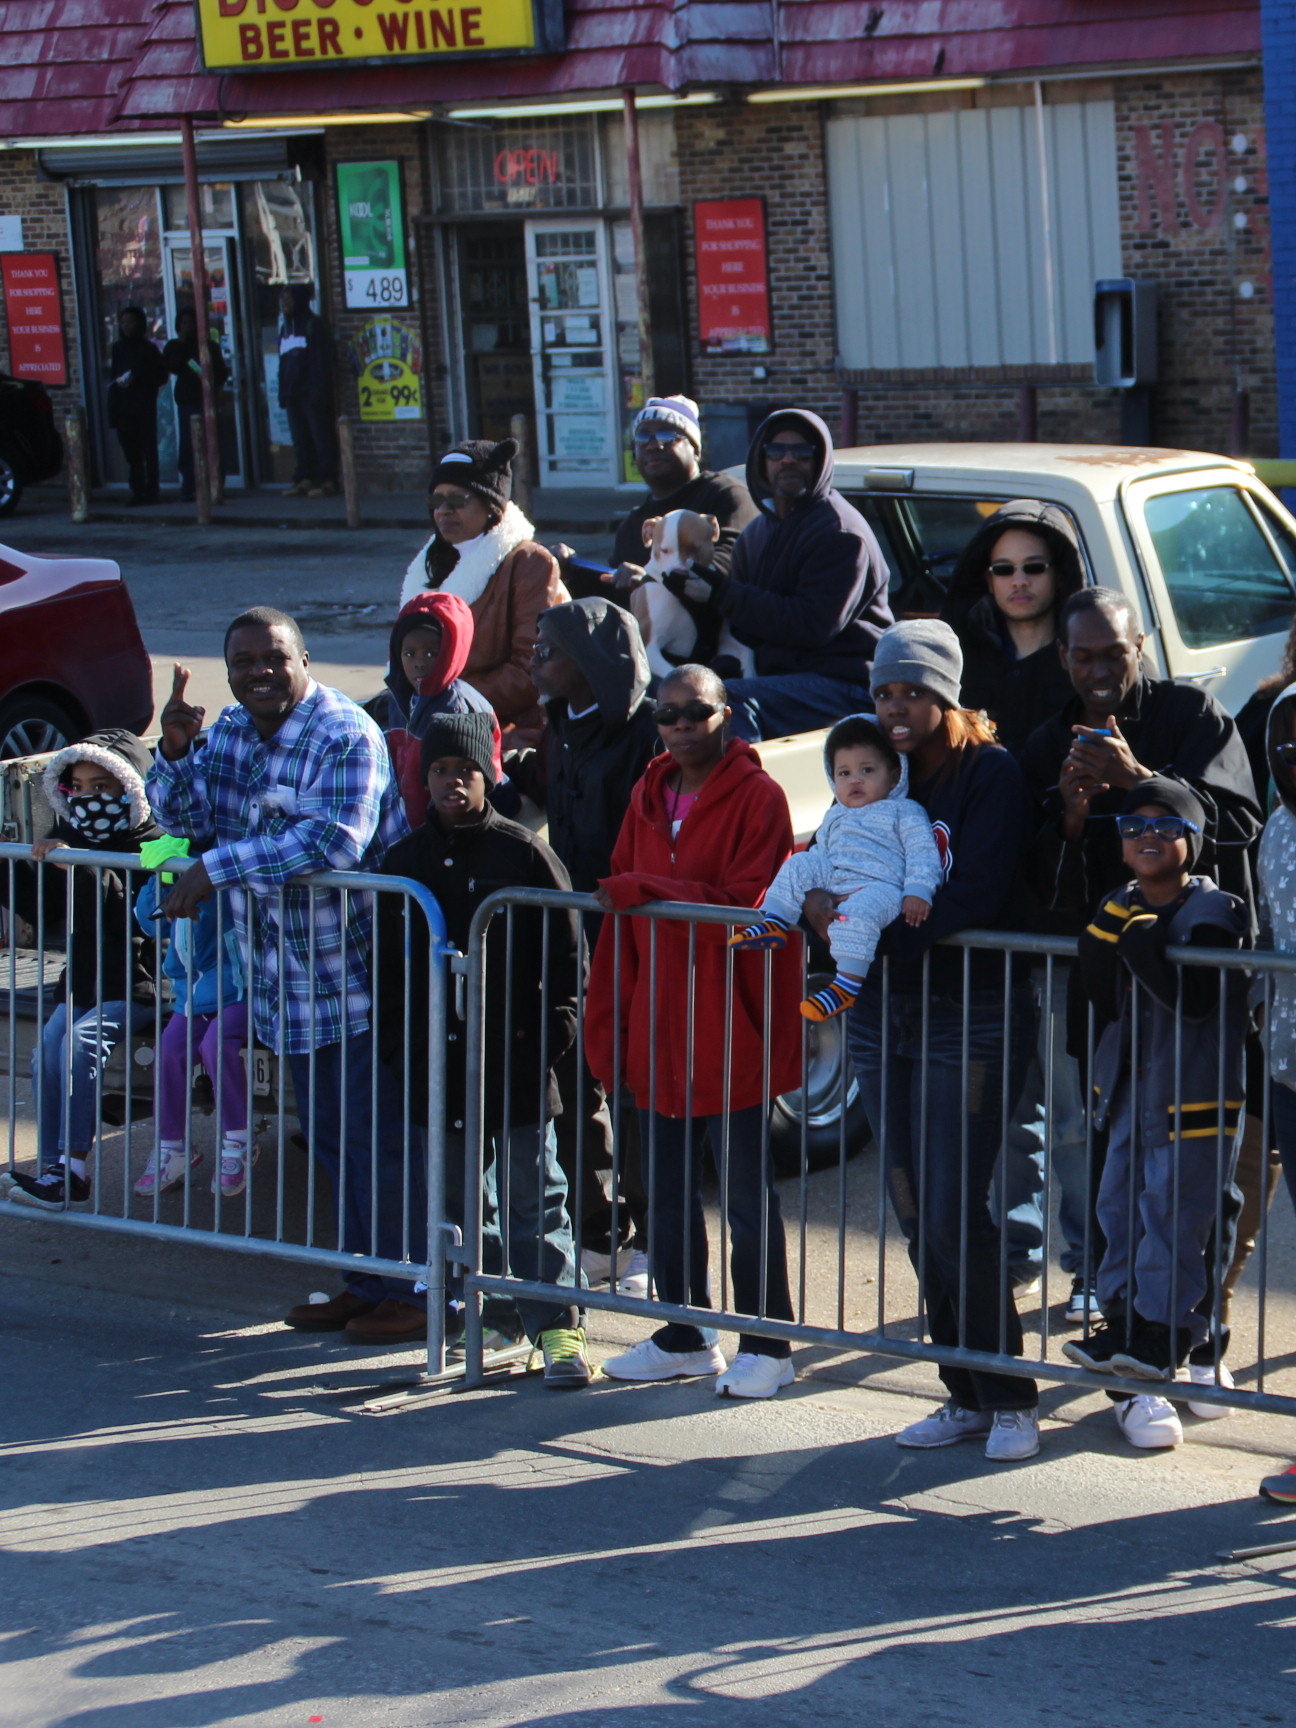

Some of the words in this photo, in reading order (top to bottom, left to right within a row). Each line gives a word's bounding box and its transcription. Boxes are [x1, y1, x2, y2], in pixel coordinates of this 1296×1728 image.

[238, 17, 344, 61] BEER
[376, 8, 485, 51] WINE
[494, 148, 558, 184] OPEN
[1133, 120, 1228, 233] NO
[706, 219, 735, 230] THANK
[737, 218, 753, 228] YOU
[721, 262, 744, 273] HERE
[11, 270, 33, 279] THANK
[34, 269, 47, 278] YOU
[9, 289, 21, 297] FOR
[22, 288, 54, 296] SHOPPING
[25, 307, 42, 316] HERE
[12, 326, 30, 335] YOUR
[31, 325, 60, 334] BUSINESS
[18, 363, 60, 372] APPRECIATED
[361, 385, 373, 407] 2
